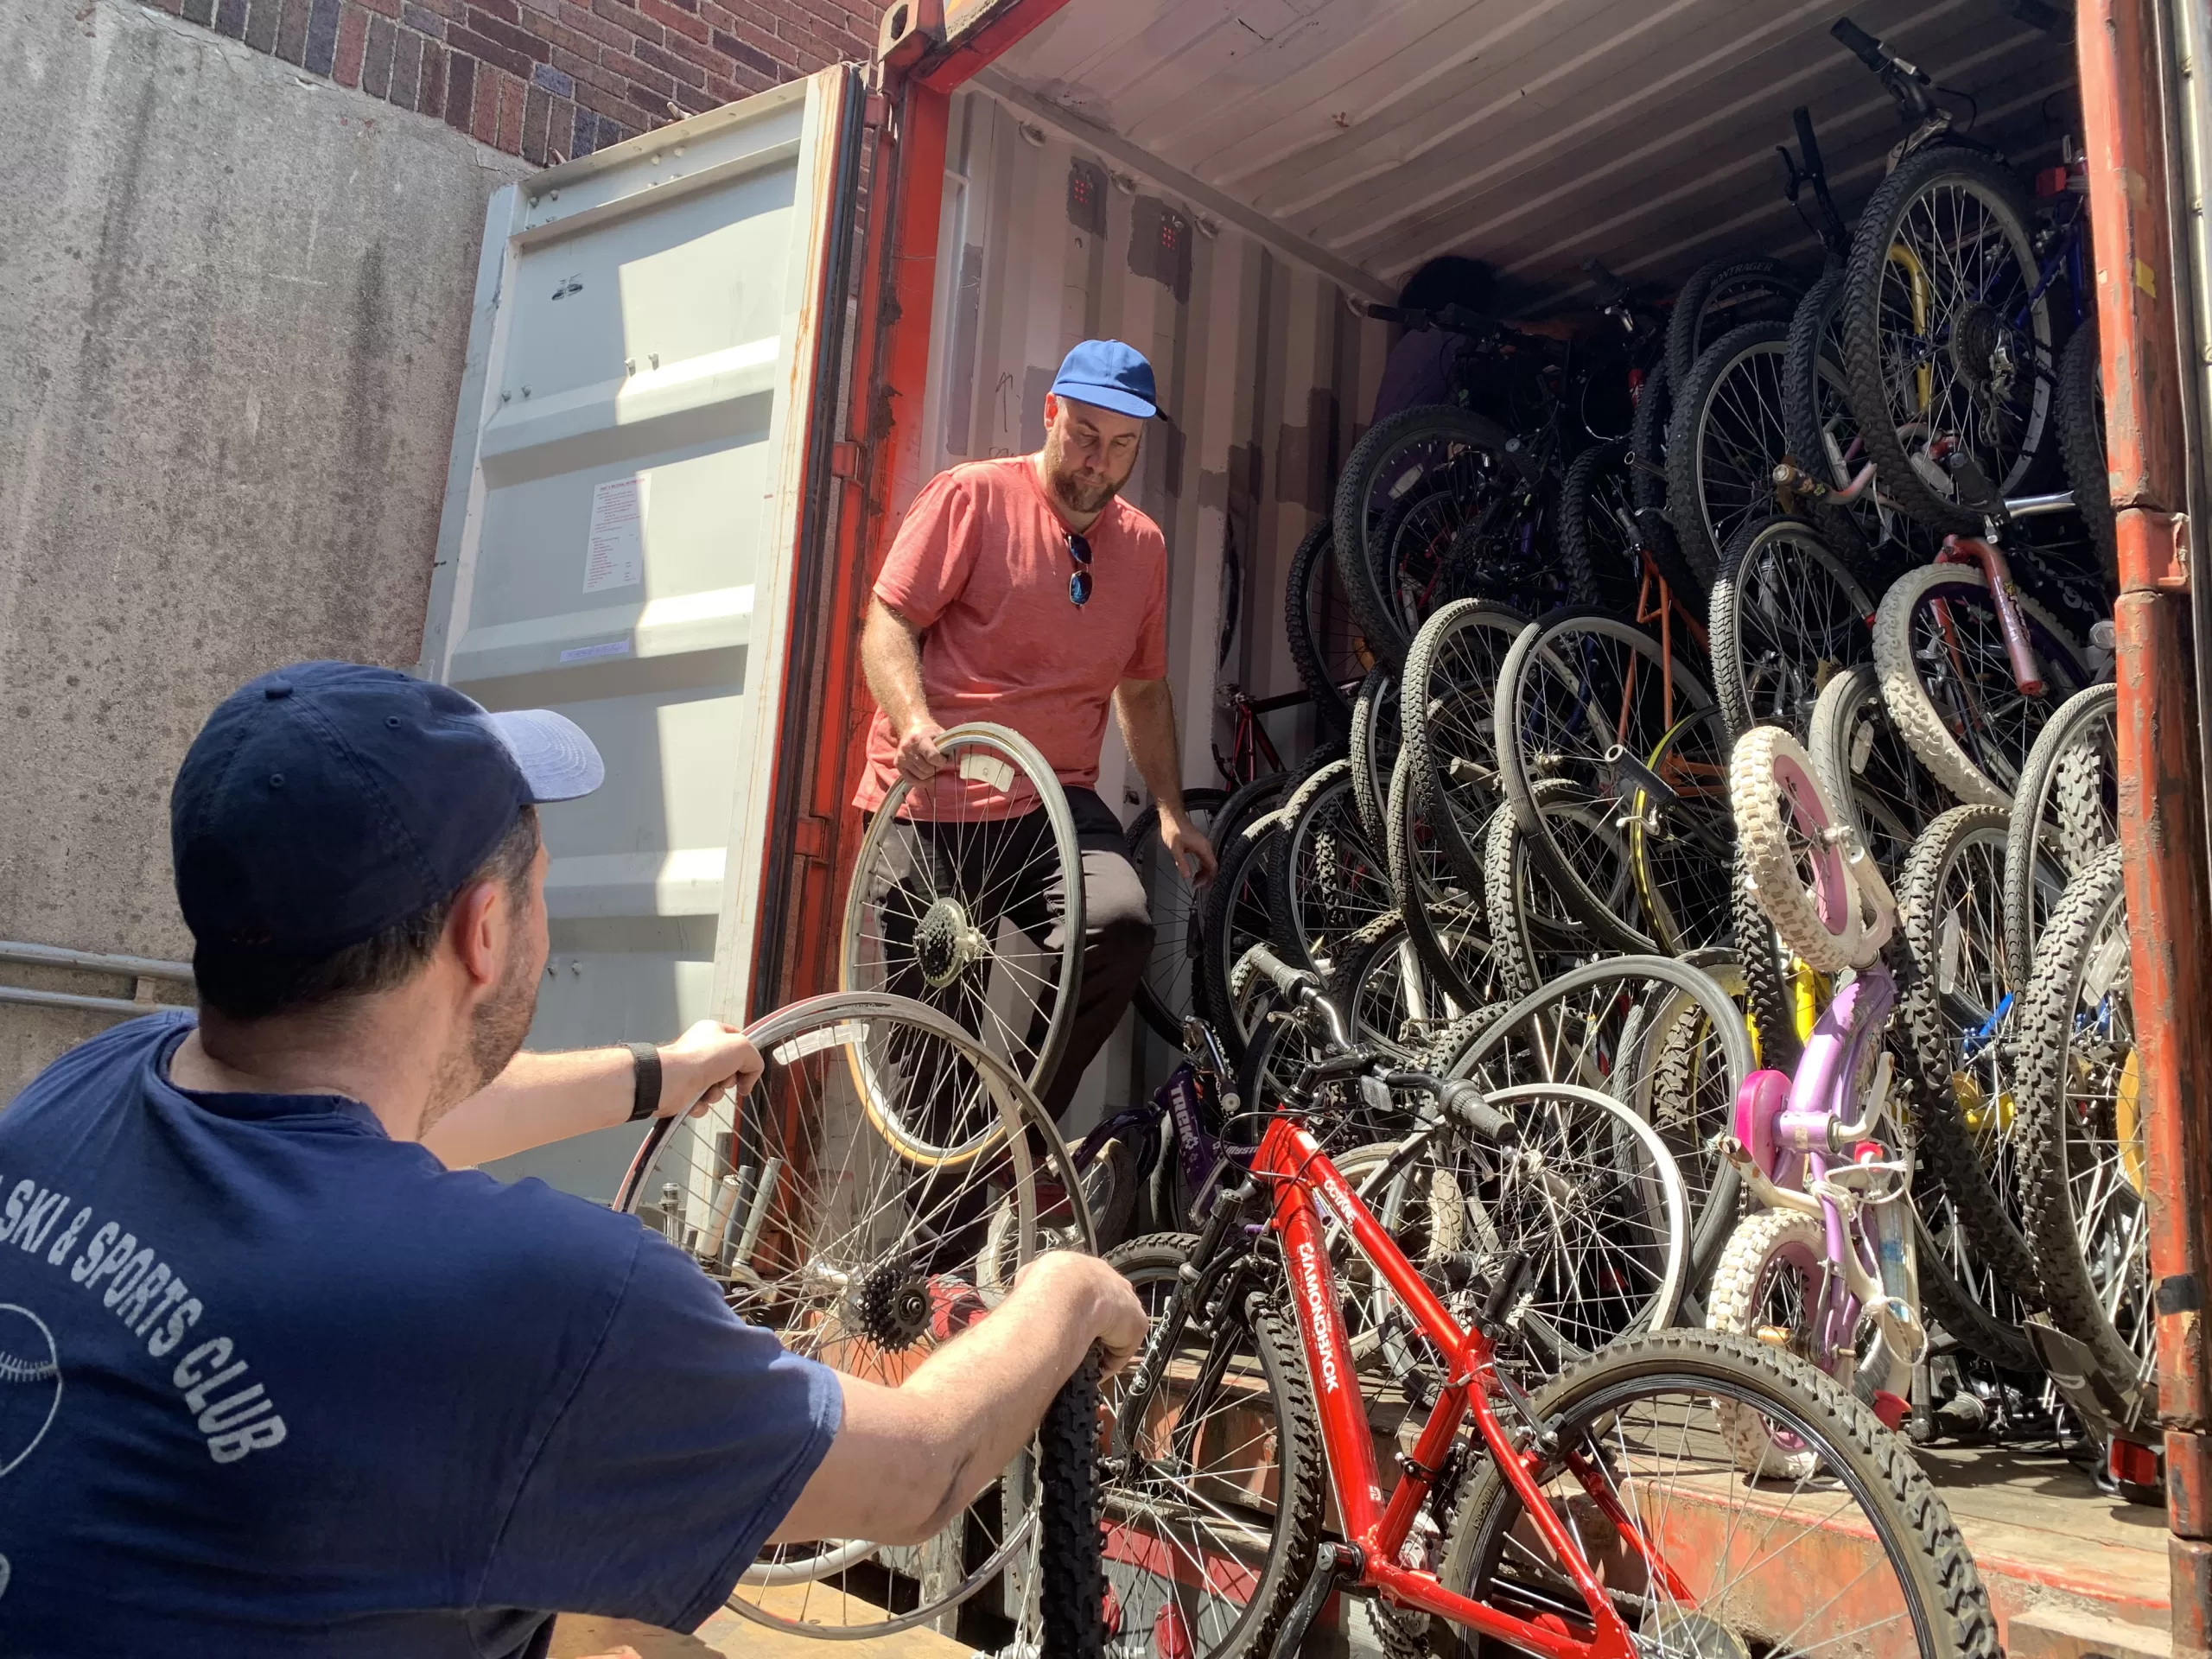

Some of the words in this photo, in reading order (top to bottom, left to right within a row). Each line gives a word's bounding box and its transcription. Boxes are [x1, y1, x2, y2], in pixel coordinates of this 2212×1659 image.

[1711, 262, 1774, 289] BONTRAGER
[1170, 1080, 1194, 1142] TREK
[1226, 1146, 1260, 1154] MYSTI
[1324, 1179, 1357, 1220] OCTANE
[0, 1179, 71, 1253] SKI
[48, 1206, 92, 1266] &
[71, 1221, 203, 1357] SPORTS
[173, 1337, 287, 1464] CLUB
[1297, 1242, 1338, 1394] DIAMONDBACK
